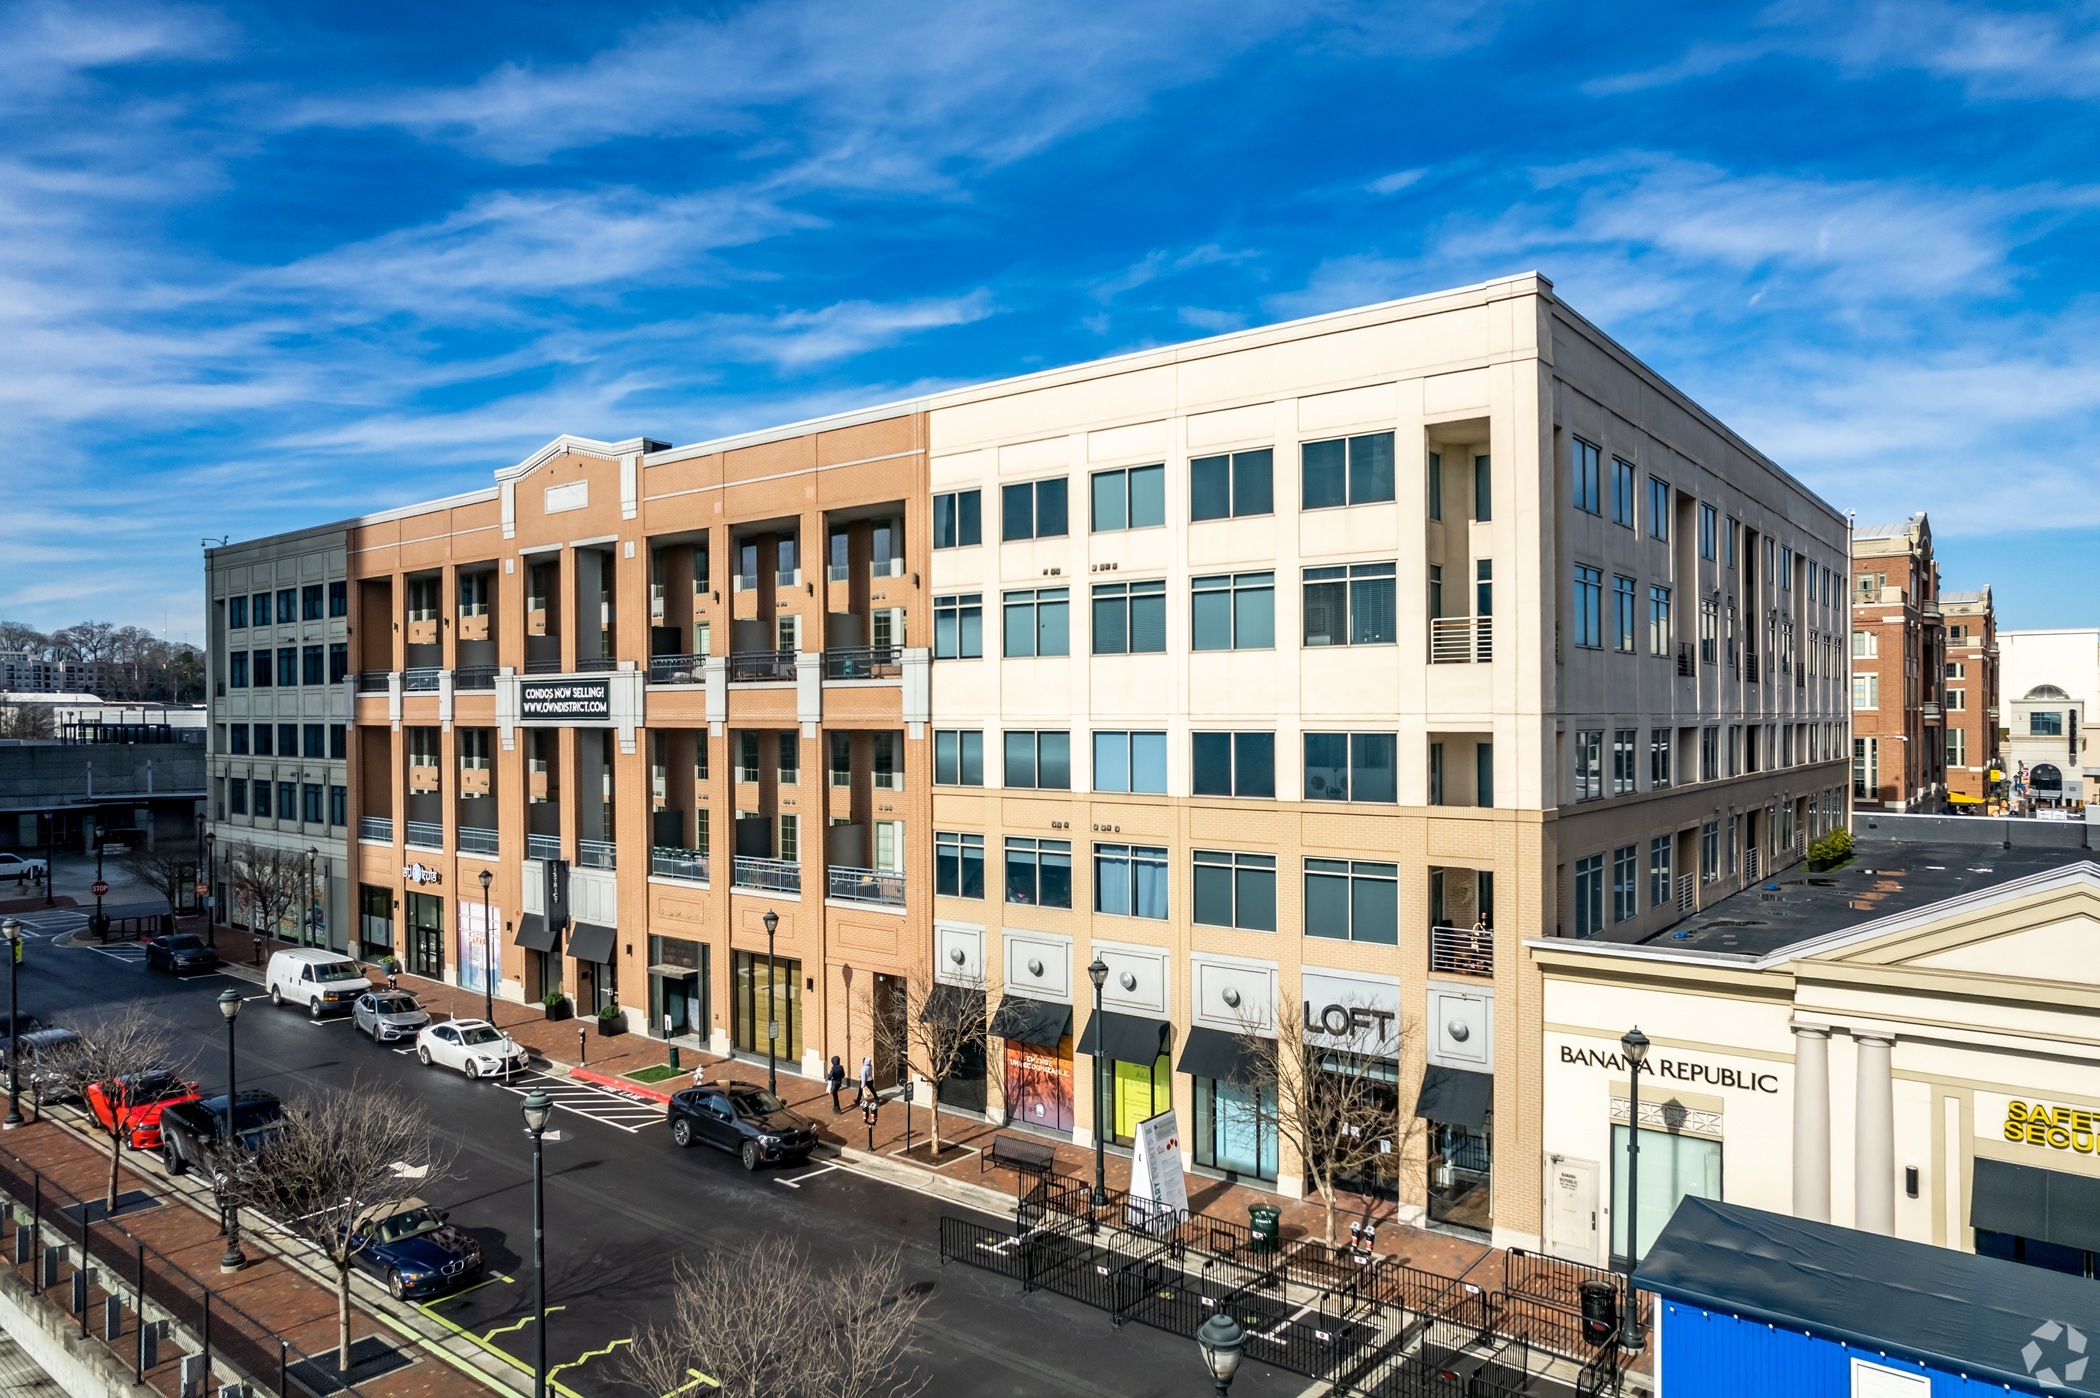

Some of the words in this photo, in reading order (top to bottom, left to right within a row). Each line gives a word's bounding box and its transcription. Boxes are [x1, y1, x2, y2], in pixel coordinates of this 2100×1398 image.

[523, 701, 607, 713] WWW.OWNDISTRICT.COM
[525, 688, 553, 699] CONDOS
[554, 687, 572, 699] NOW
[572, 686, 604, 698] SELLING!
[92, 884, 108, 892] STOP
[1303, 1000, 1395, 1043] LOFT
[1560, 1045, 1655, 1075] BANANA
[1660, 1059, 1778, 1093] REPUBLIC
[2004, 1120, 2100, 1155] SECU
[1148, 1139, 1159, 1180] EVENTS
